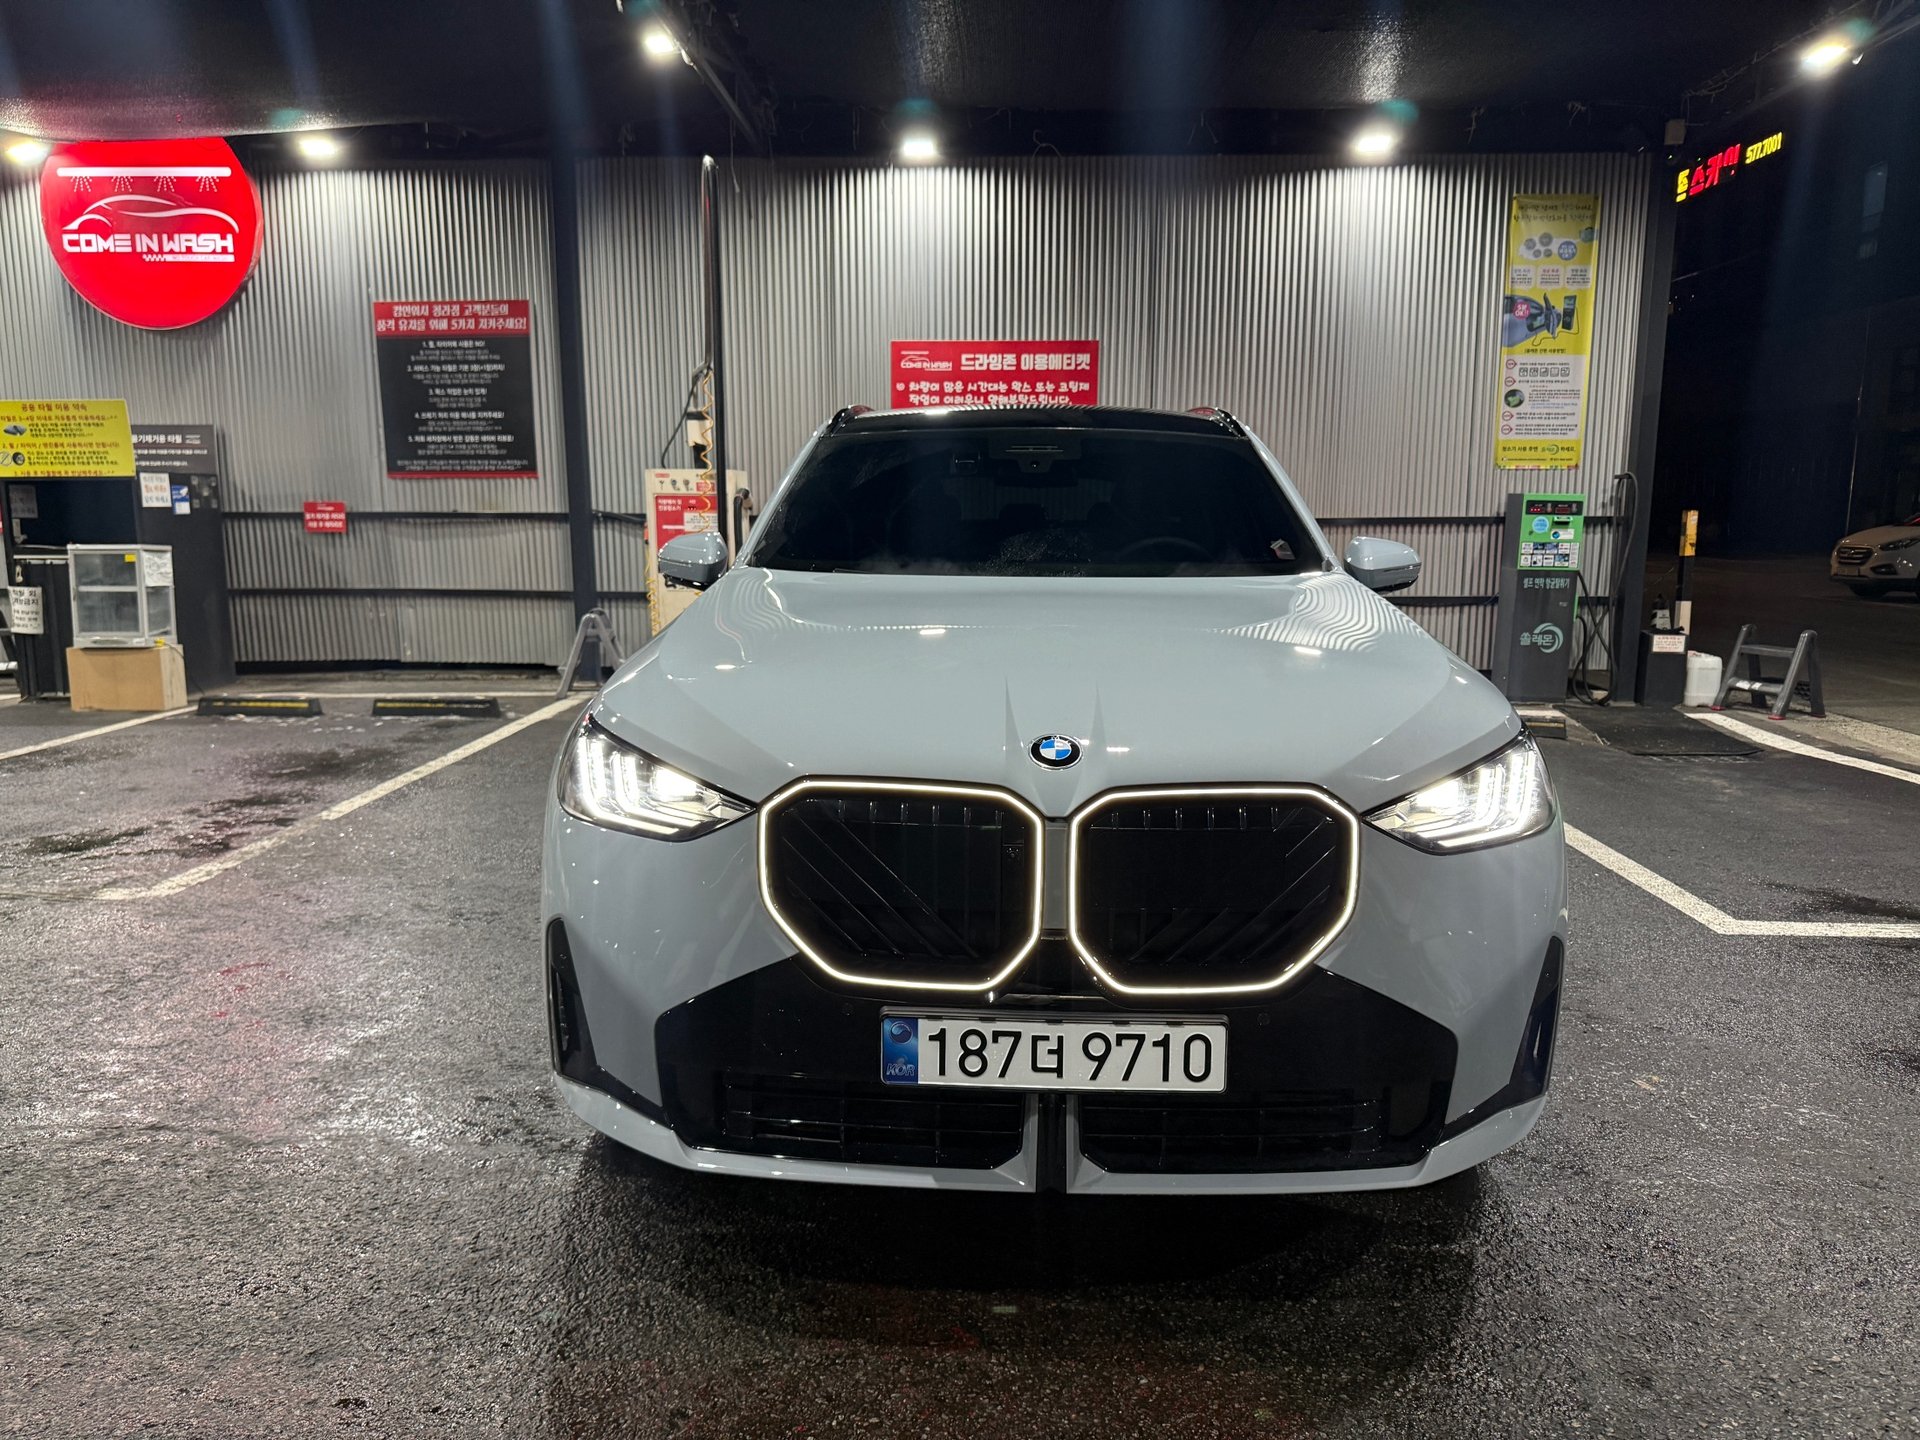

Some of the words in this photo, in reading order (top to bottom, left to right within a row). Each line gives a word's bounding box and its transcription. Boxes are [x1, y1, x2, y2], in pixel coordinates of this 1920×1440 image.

[62, 233, 131, 253] COME
[134, 233, 160, 253] IN
[162, 233, 234, 253] WASH
[399, 319, 426, 331] 유지를
[429, 318, 448, 330] 위해
[451, 318, 476, 330] 5가지
[478, 317, 527, 330] 지켜주세요!
[960, 353, 1017, 371] 드라잉존
[1020, 353, 1091, 371] 이용에티켓
[909, 381, 940, 392] 차량이
[943, 381, 964, 392] 많은
[967, 381, 1008, 392] 시간대는
[1011, 381, 1032, 392] 왁스
[1034, 381, 1055, 392] 또는
[909, 394, 940, 406] 작업이
[943, 394, 984, 406] 어려우니
[167, 434, 182, 444] 타월
[1523, 578, 1534, 589] 셀프
[1520, 632, 1554, 646] 쏠레몬
[928, 1027, 1064, 1079] 187더
[1081, 1031, 1213, 1083] 9710
[885, 1063, 916, 1078] KOR
